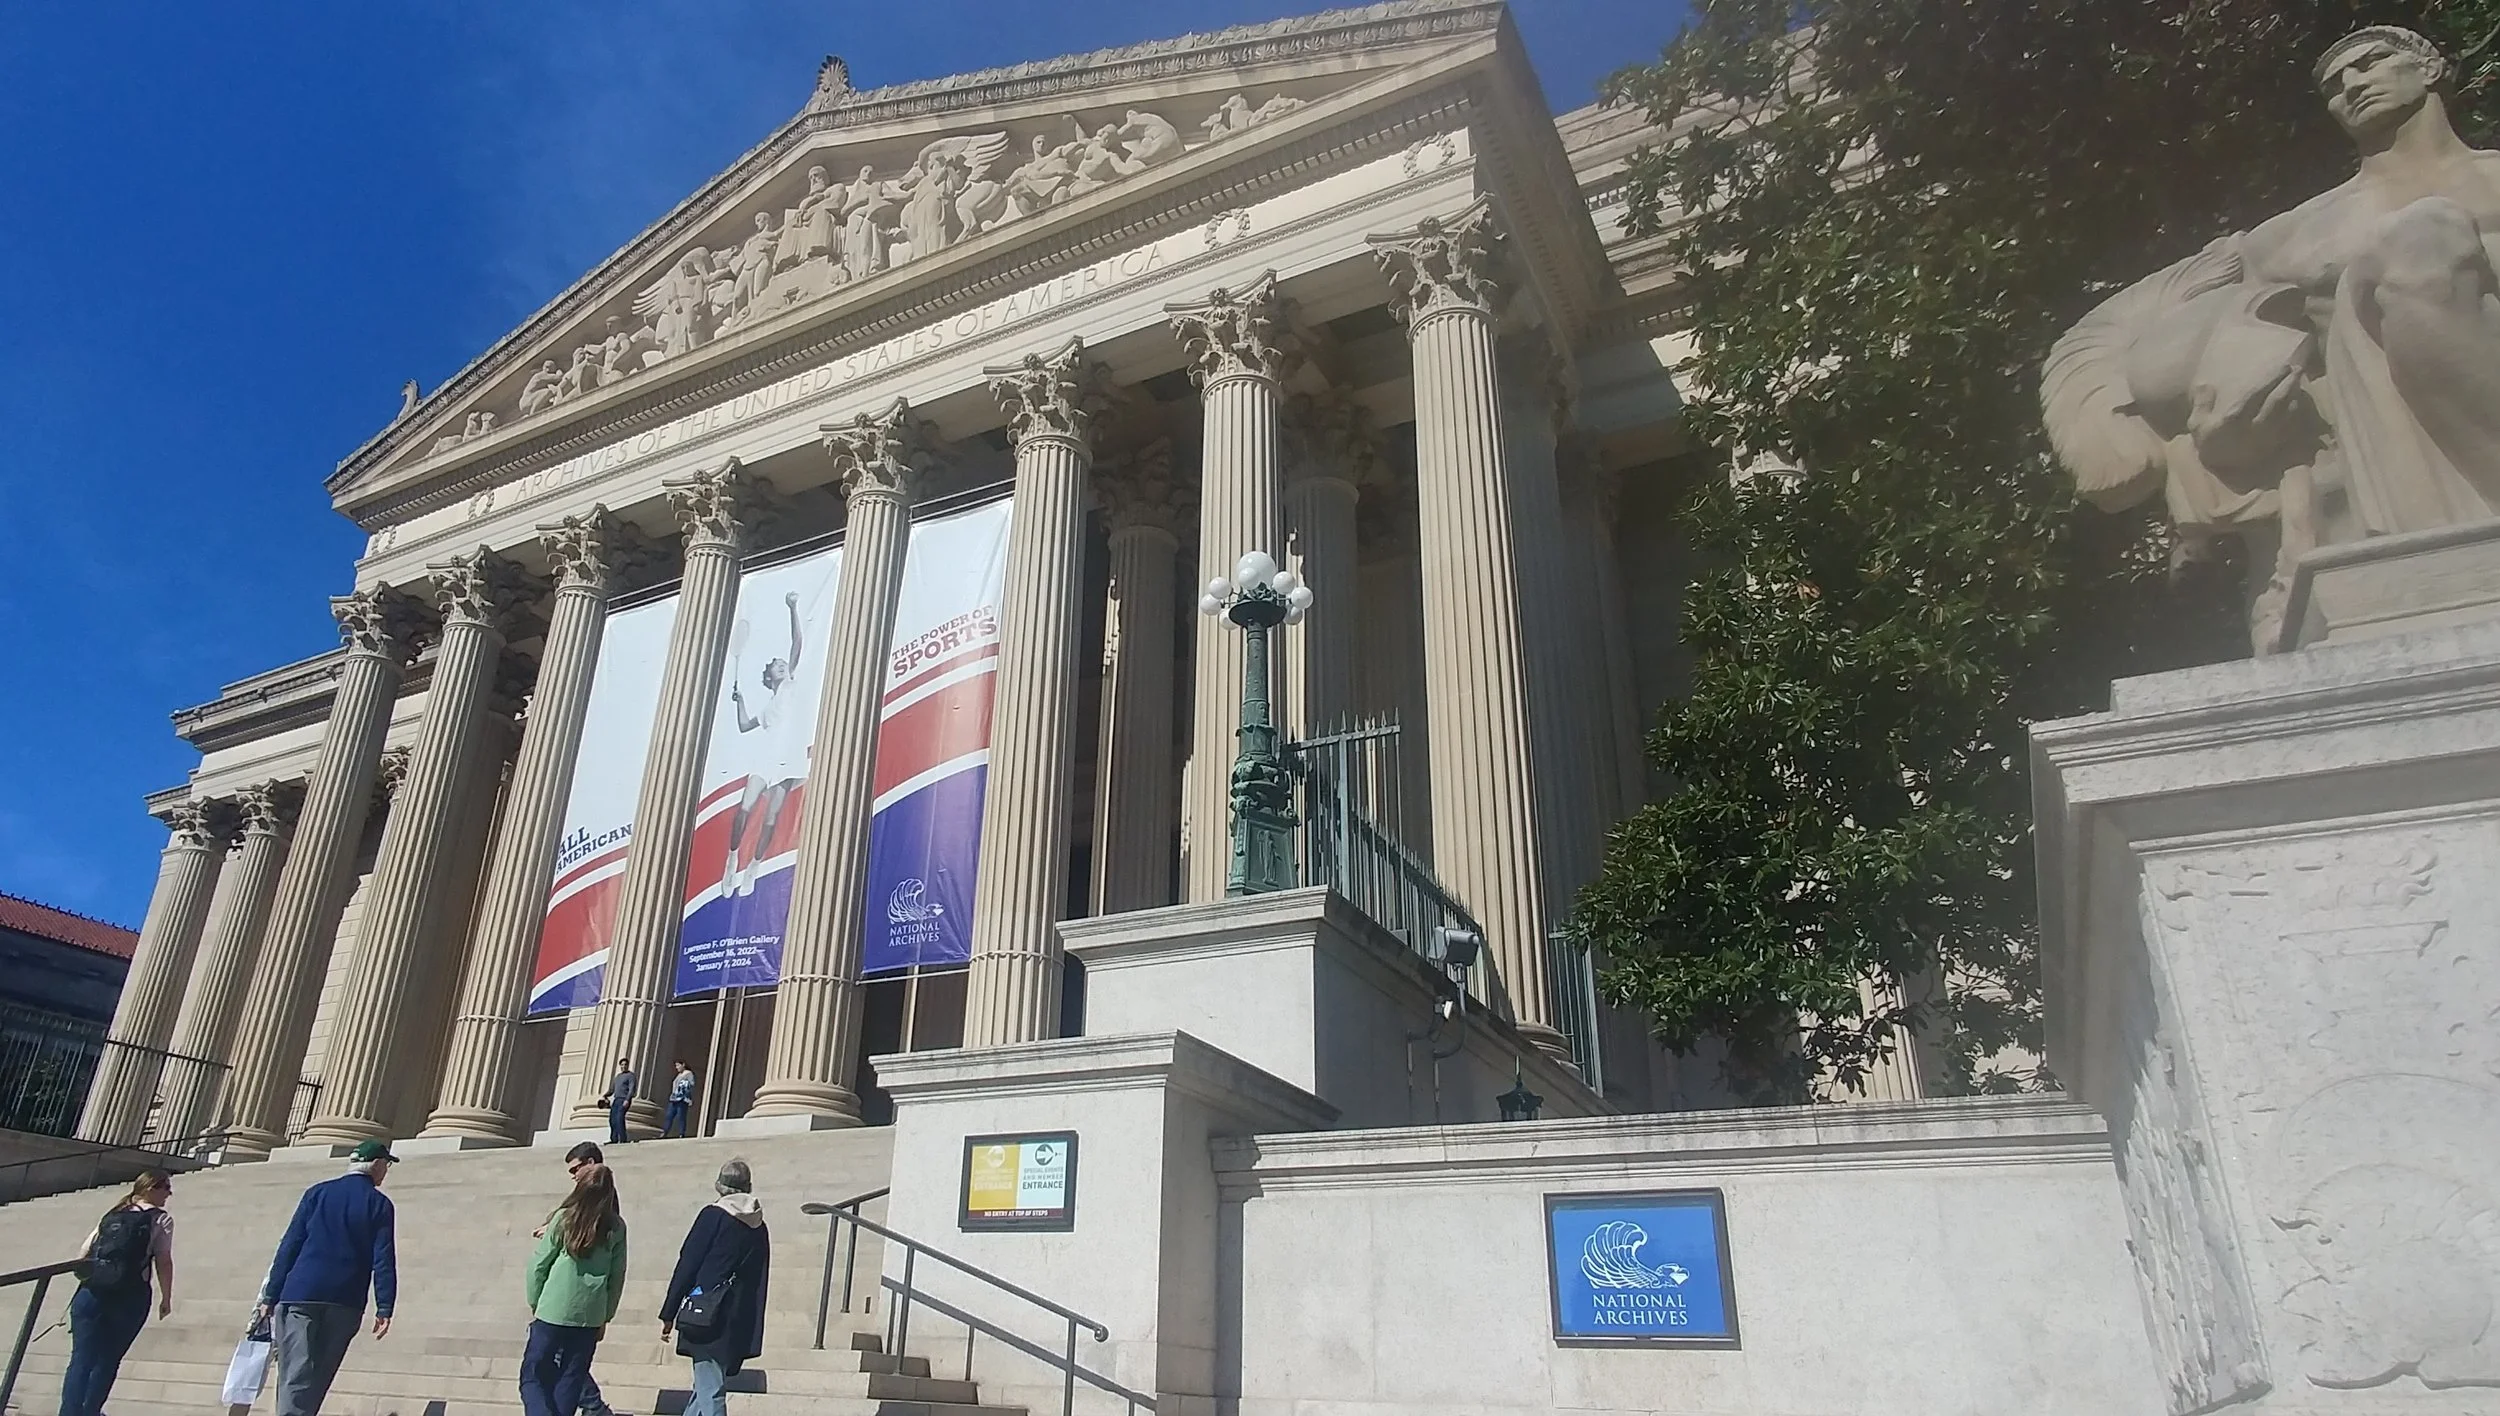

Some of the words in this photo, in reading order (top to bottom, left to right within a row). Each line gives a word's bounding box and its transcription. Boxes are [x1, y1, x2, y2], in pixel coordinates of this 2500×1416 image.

[514, 441, 629, 501] ARCHIVES
[637, 429, 668, 455] OF
[677, 412, 722, 442] THE
[732, 367, 833, 420] UNITED
[843, 324, 944, 380] STATES
[955, 305, 995, 337] OF
[1002, 243, 1165, 323] AMERICA
[892, 638, 919, 660] THE
[920, 613, 970, 645] POWER
[972, 605, 993, 619] OF
[893, 616, 997, 679] SPORTS
[560, 826, 590, 856] ALL
[556, 823, 633, 875] AMERICAN
[889, 921, 940, 936] NATIONAL
[683, 943, 712, 955] Lawrence
[712, 940, 719, 949] F.
[719, 936, 748, 947] O'Brien
[749, 935, 780, 945] Gallery
[888, 932, 940, 947] ARCHIVES
[689, 951, 725, 964] September
[696, 961, 723, 972] January
[723, 959, 731, 968] 7,
[731, 957, 752, 967] 2024
[1022, 1180, 1064, 1190] ENTRANCE
[1592, 1293, 1687, 1308] NATIONAL
[1593, 1310, 1688, 1325] ARCHIVES
